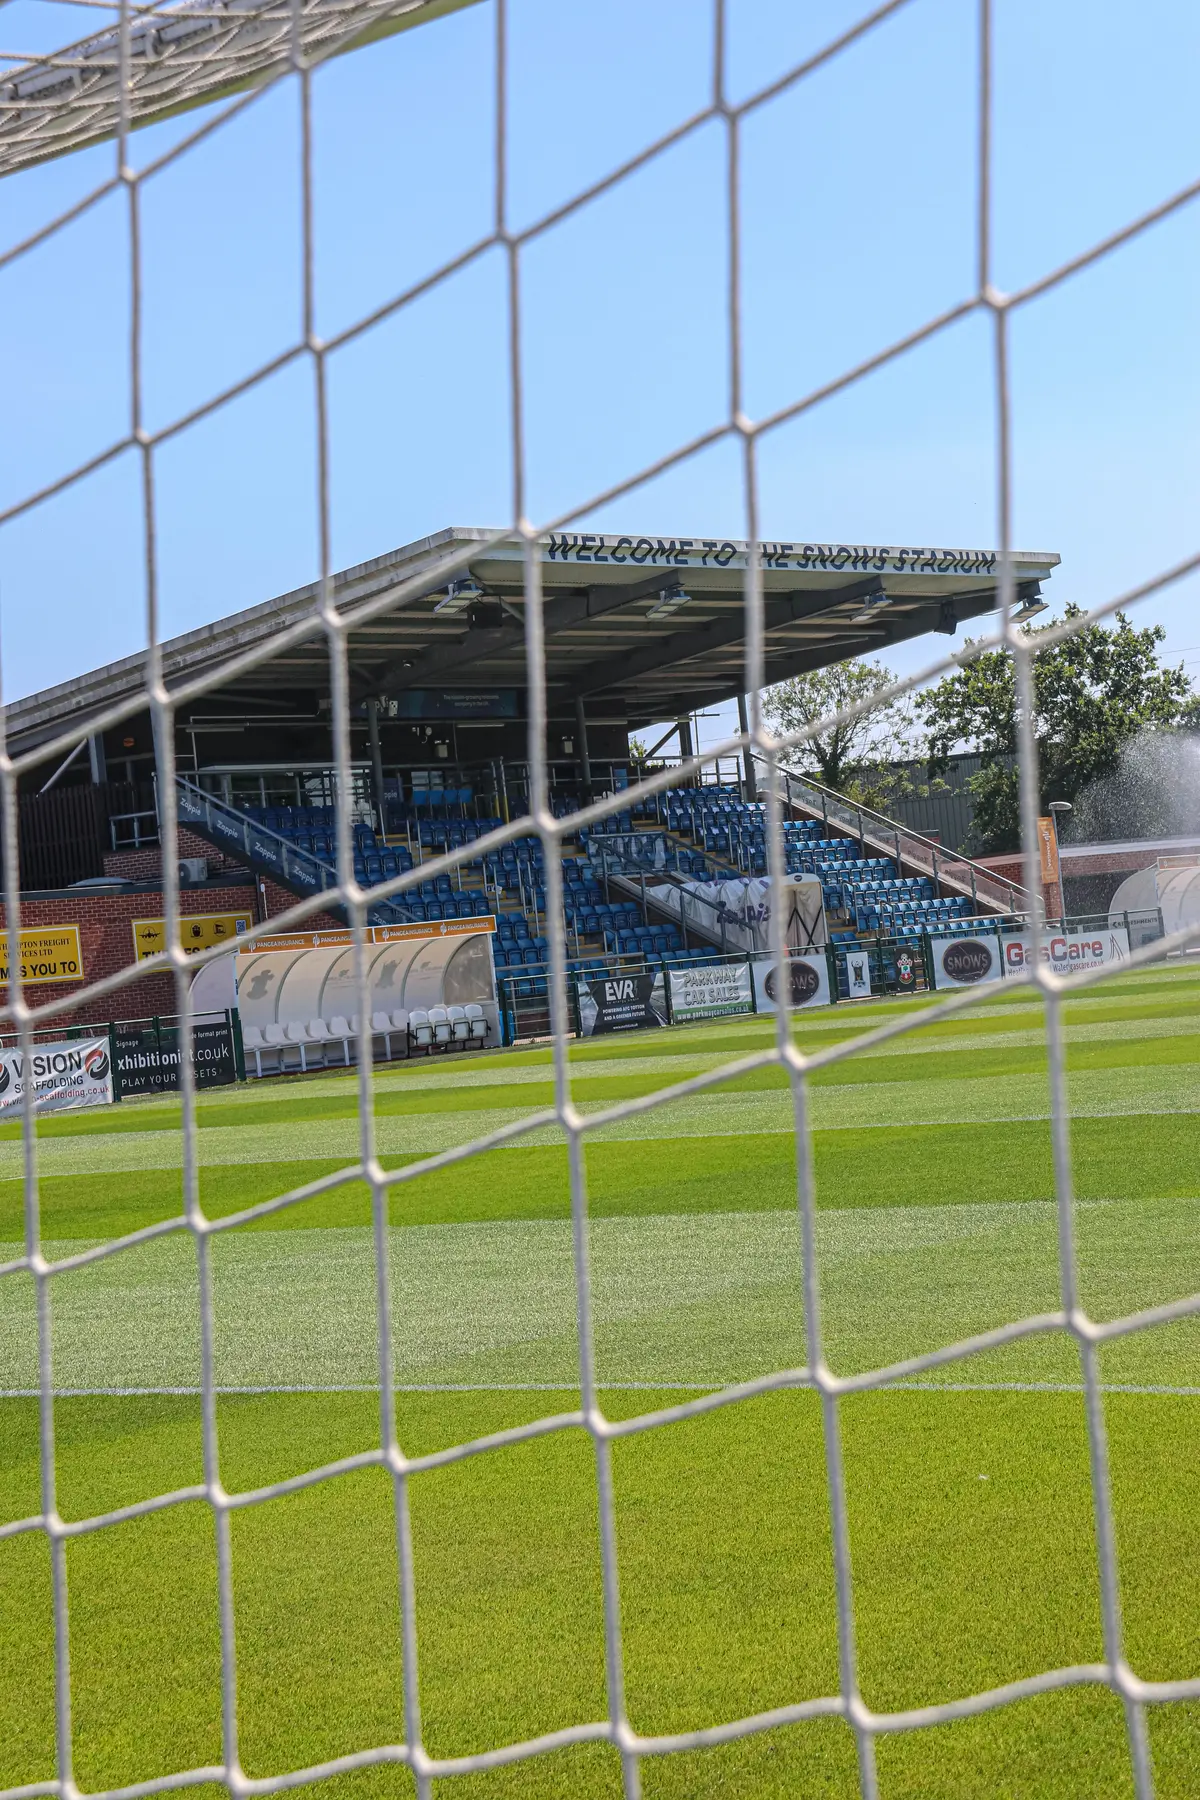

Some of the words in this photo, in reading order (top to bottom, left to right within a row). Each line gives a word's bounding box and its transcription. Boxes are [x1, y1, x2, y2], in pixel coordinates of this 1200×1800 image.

[548, 534, 694, 565] WELCOME
[702, 542, 738, 567] TO
[796, 545, 890, 572] SNOWS
[893, 550, 996, 574] STADIUM
[180, 798, 201, 816] Zappie
[216, 820, 239, 838] Zappie
[255, 842, 277, 861] Zappie
[294, 866, 316, 884] Zappie
[40, 938, 70, 948] FREIGHT
[4, 950, 37, 960] SVICES
[948, 952, 988, 970] SNOWS
[1006, 938, 1103, 967] GasCare
[0, 965, 27, 980] MS
[30, 962, 56, 976] YOU
[60, 960, 76, 974] TO
[1069, 958, 1104, 972] gascare.co.uk
[684, 968, 737, 988] PARKWAY
[770, 974, 816, 990] SOWS
[605, 980, 634, 1001] EVR
[684, 990, 706, 1006] CAR
[709, 986, 740, 1002] SALES
[677, 1005, 749, 1020] www.parkwaycarsales.co.uk
[198, 1030, 214, 1038] format
[216, 1029, 228, 1037] print
[116, 1040, 138, 1048] Signage
[118, 1043, 230, 1070] xhibitionit.co.uk
[15, 1076, 83, 1093] SCAFFOLDING
[121, 1076, 146, 1088] PLAY
[150, 1073, 176, 1084] YOUR
